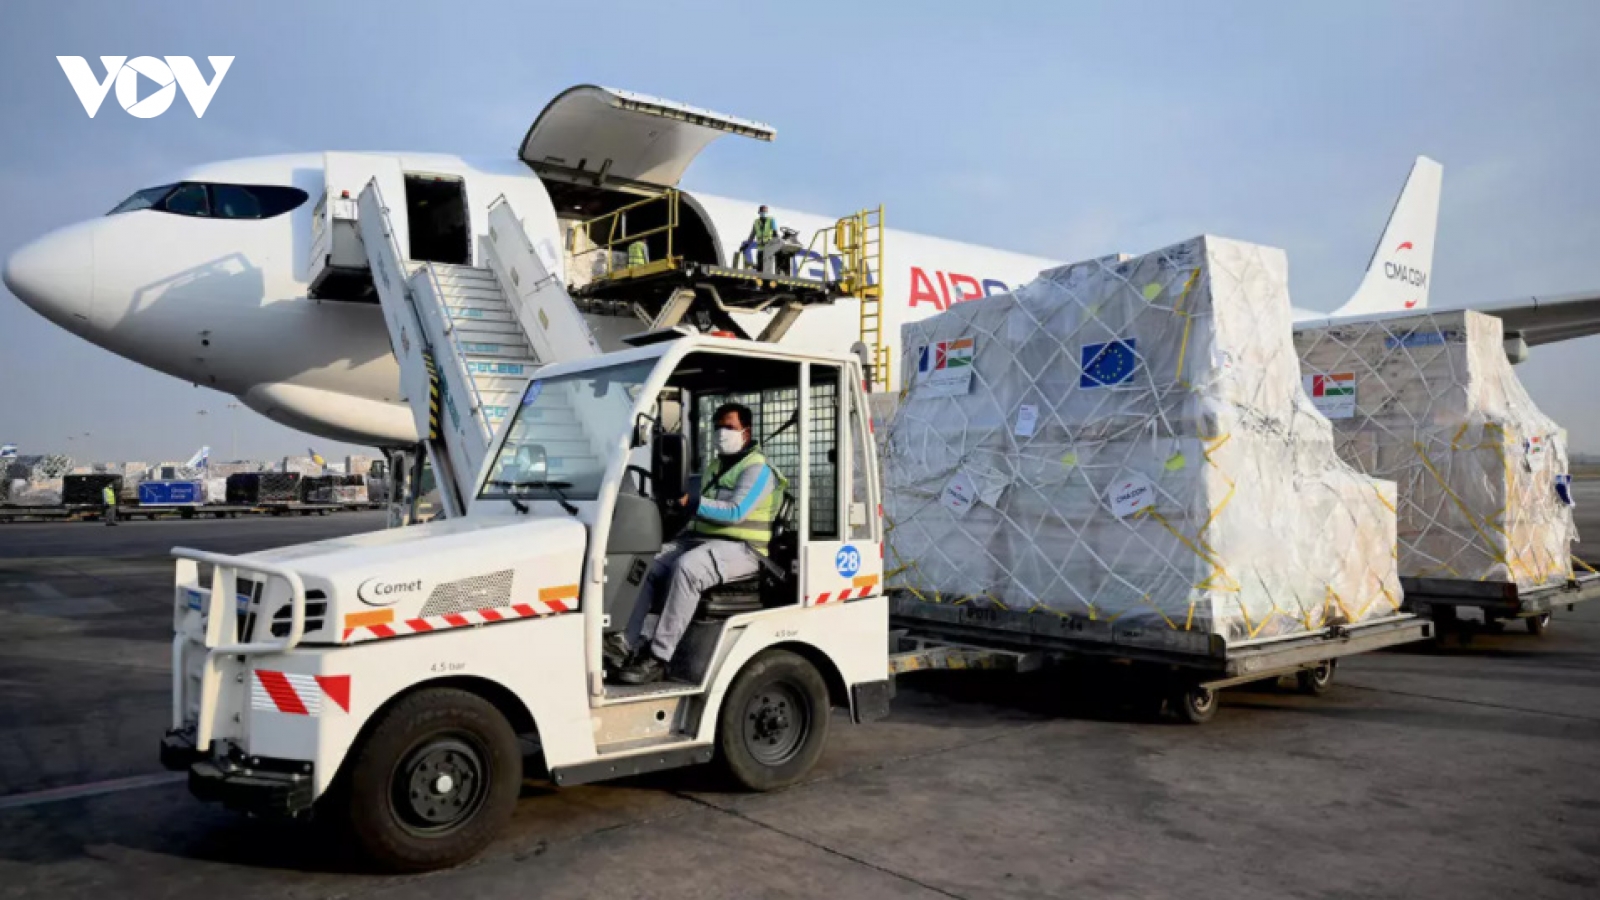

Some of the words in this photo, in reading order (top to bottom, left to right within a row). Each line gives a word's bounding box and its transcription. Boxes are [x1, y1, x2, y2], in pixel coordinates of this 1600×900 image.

[838, 550, 858, 572] 28
[374, 578, 422, 596] Comet
[430, 661, 446, 672] 4.5
[448, 661, 466, 671] bar
